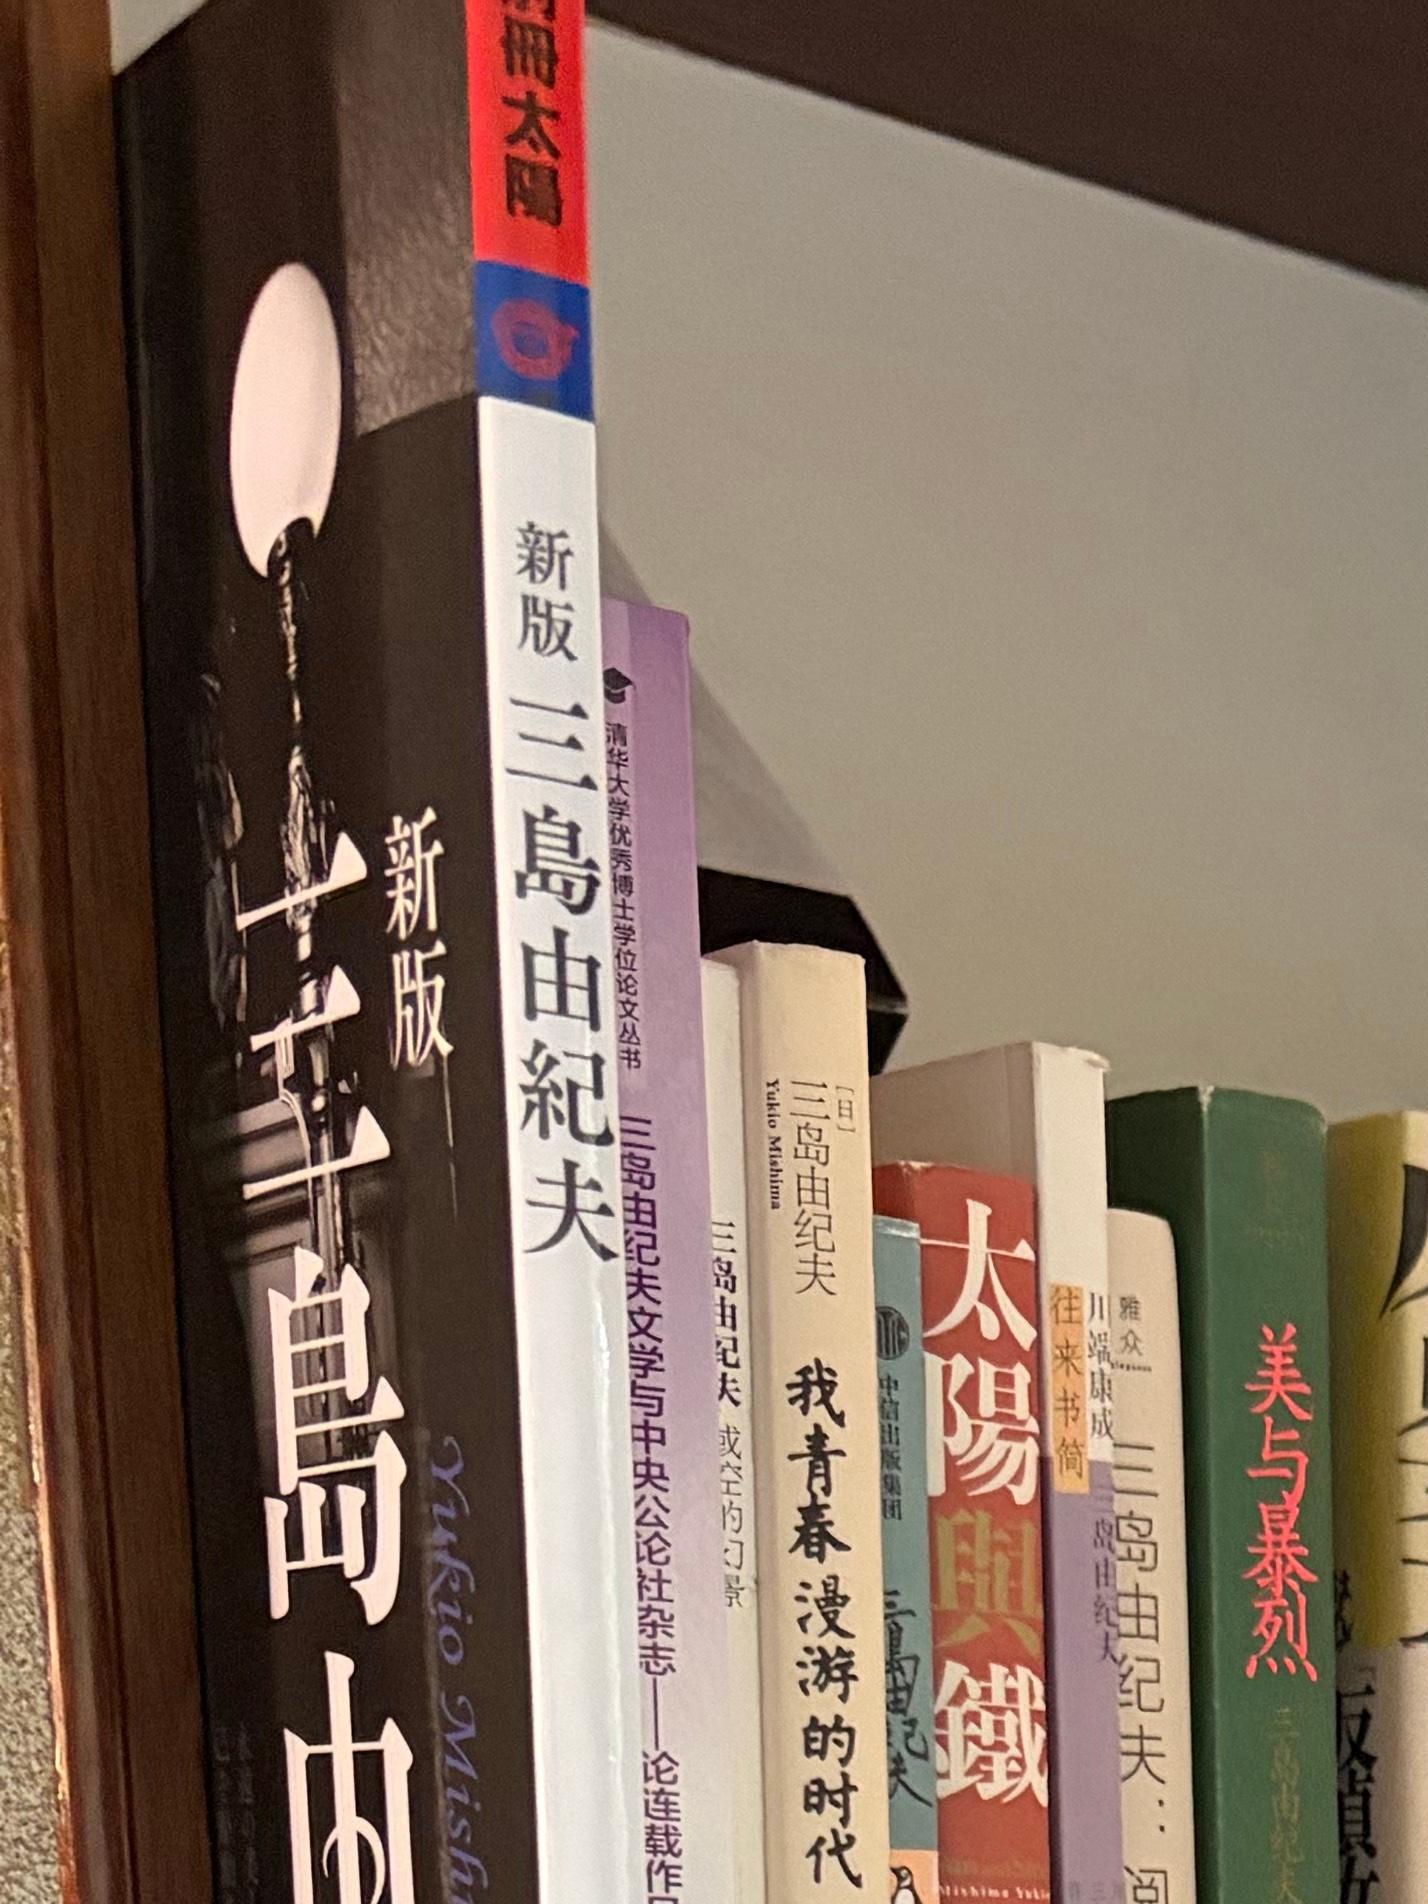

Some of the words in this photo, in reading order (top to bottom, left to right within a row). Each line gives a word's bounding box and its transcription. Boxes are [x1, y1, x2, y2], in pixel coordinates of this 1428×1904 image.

[500, 0, 564, 228] 冊太陽
[516, 520, 578, 662] 新版
[384, 808, 453, 1071] 新版
[506, 692, 620, 1263] 三島由紀夫
[604, 722, 641, 1070] 清华大学优秀博士学位论文丛书
[766, 1078, 780, 1130] Yukio
[767, 1137, 783, 1210] Mishima
[790, 1078, 838, 1296] 三岛由纪夫
[1050, 1291, 1084, 1481] 往来书简
[1087, 1293, 1115, 1441] 川端康成
[1117, 1295, 1143, 1359] 雅众
[921, 1198, 1050, 1810] 太陽與鐵
[1241, 1322, 1319, 1683] 美与暴烈
[785, 1357, 864, 1889] 我青春漫游的时代
